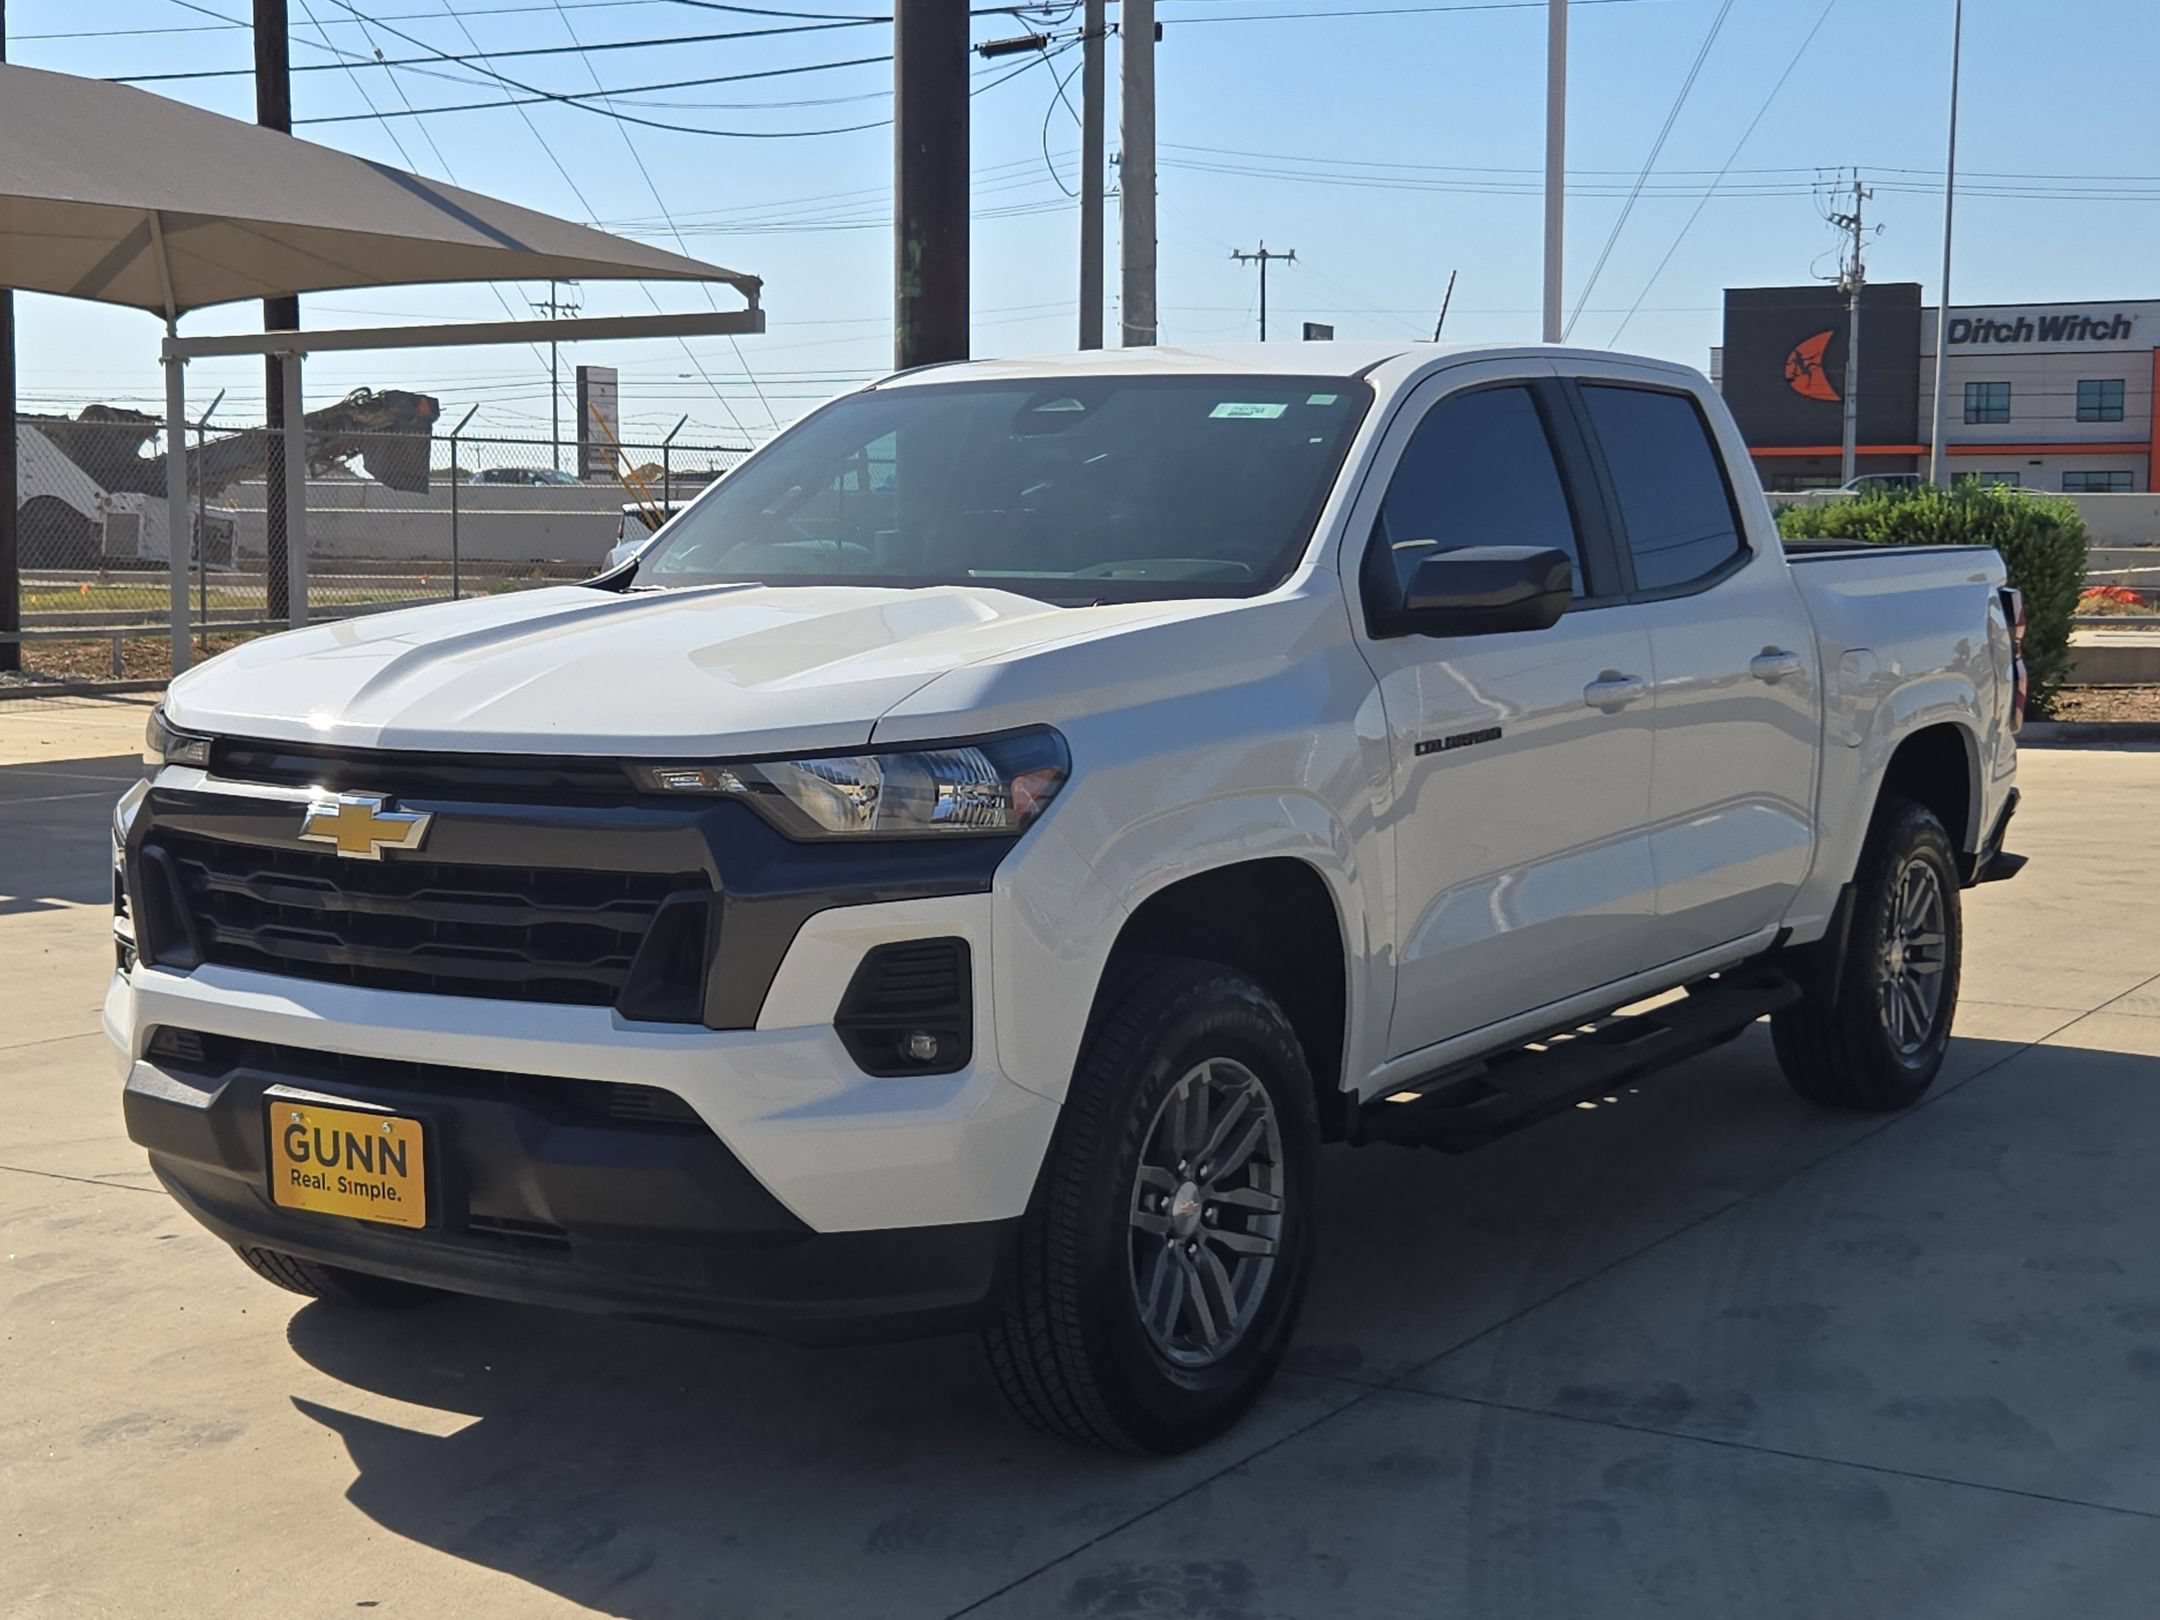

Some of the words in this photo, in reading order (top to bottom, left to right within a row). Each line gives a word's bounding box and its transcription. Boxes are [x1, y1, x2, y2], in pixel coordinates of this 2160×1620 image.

[1947, 316, 2034, 345] Ditch
[2037, 313, 2132, 342] Witch
[283, 1123, 408, 1179] GUNN
[290, 1168, 331, 1192] Real.
